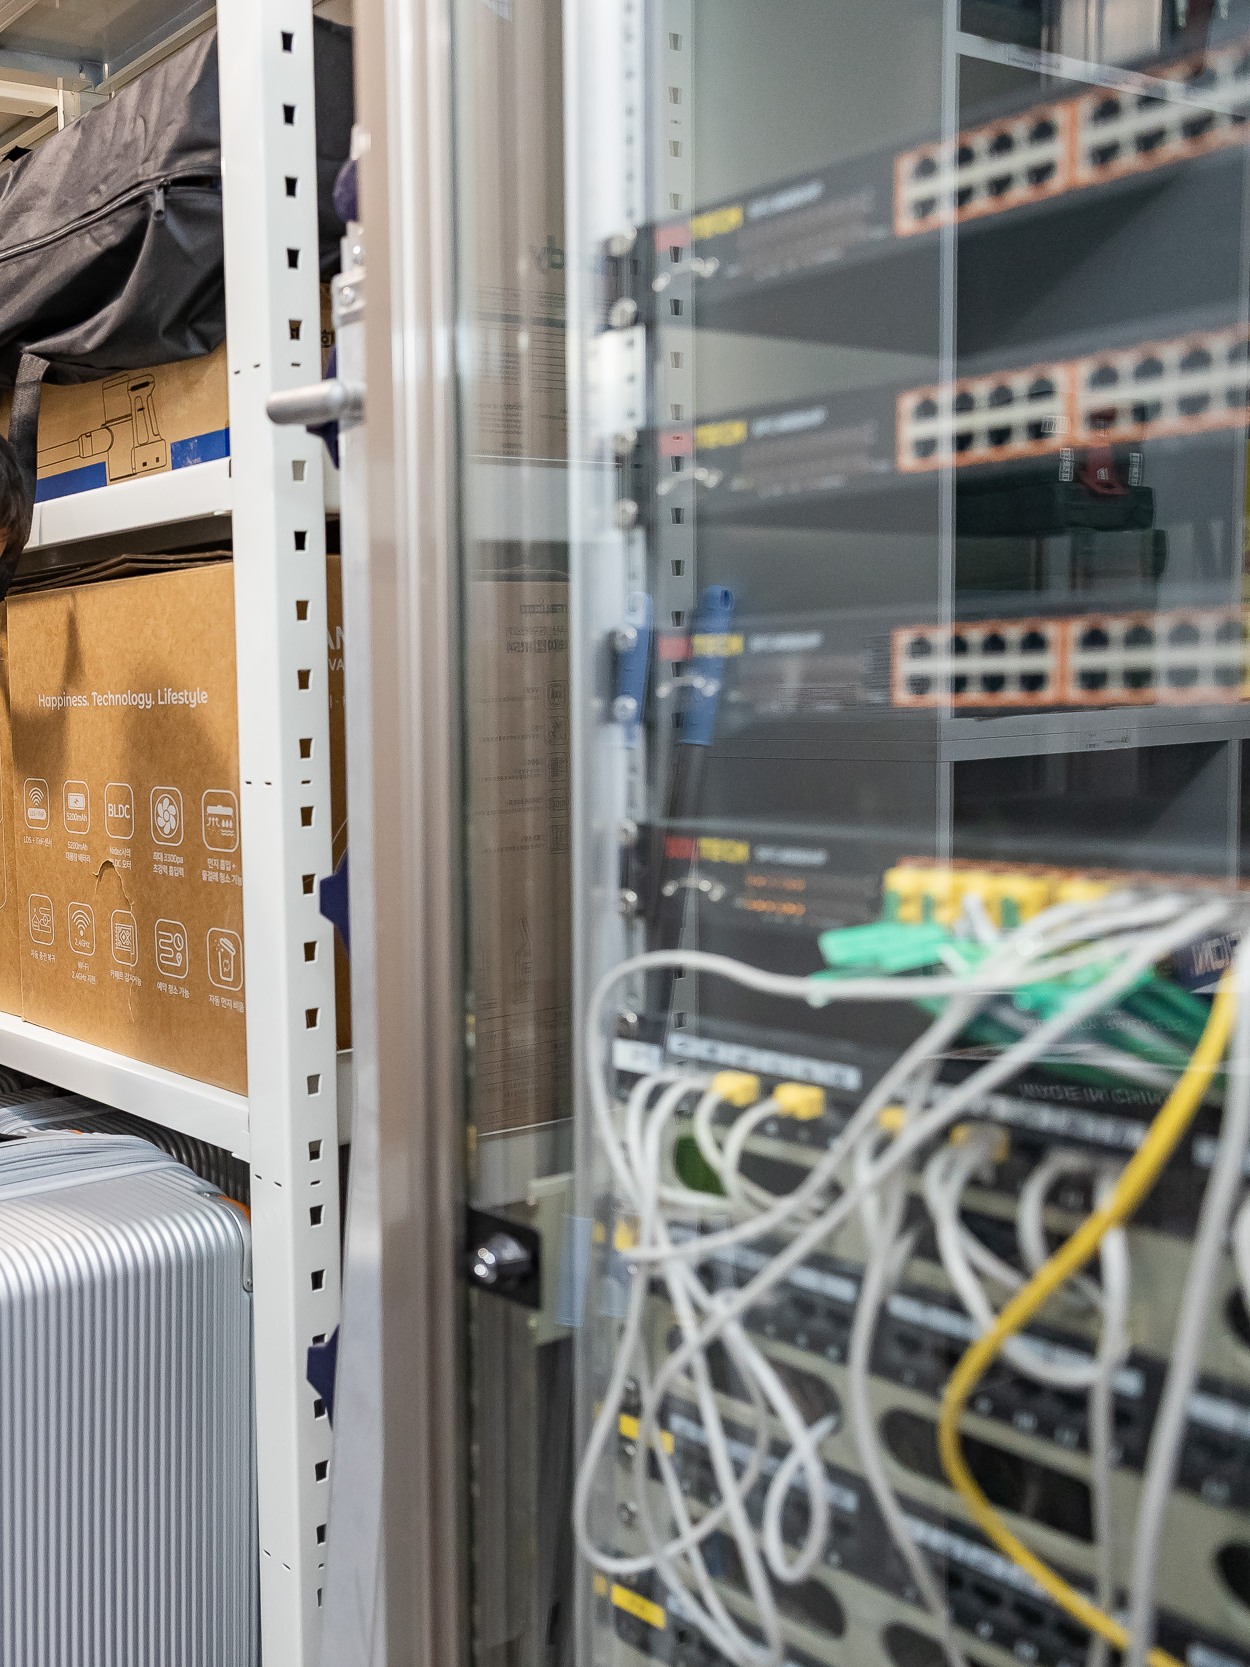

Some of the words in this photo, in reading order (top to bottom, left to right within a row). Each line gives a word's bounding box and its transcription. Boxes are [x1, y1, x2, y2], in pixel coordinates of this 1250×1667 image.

[38, 692, 90, 710] Happiness.
[91, 689, 155, 709] Technology.
[157, 686, 209, 708] Lifestyle
[66, 812, 88, 822] 5200mAh
[107, 803, 131, 819] BLDC
[67, 841, 88, 851] 5200mAh
[152, 851, 163, 863] 최대
[152, 863, 168, 876] 초강력
[168, 865, 185, 878] 흡입력
[207, 857, 219, 870] 먼지
[219, 859, 231, 872] 흡입
[201, 869, 219, 882] 물걸레
[219, 872, 231, 884] 청소
[74, 937, 91, 949] 2.4GHz
[71, 970, 87, 982] 2.4GHz
[156, 981, 168, 992] 예약
[168, 984, 179, 995] 청소
[208, 994, 220, 1007] 자동
[220, 996, 233, 1010] 먼지
